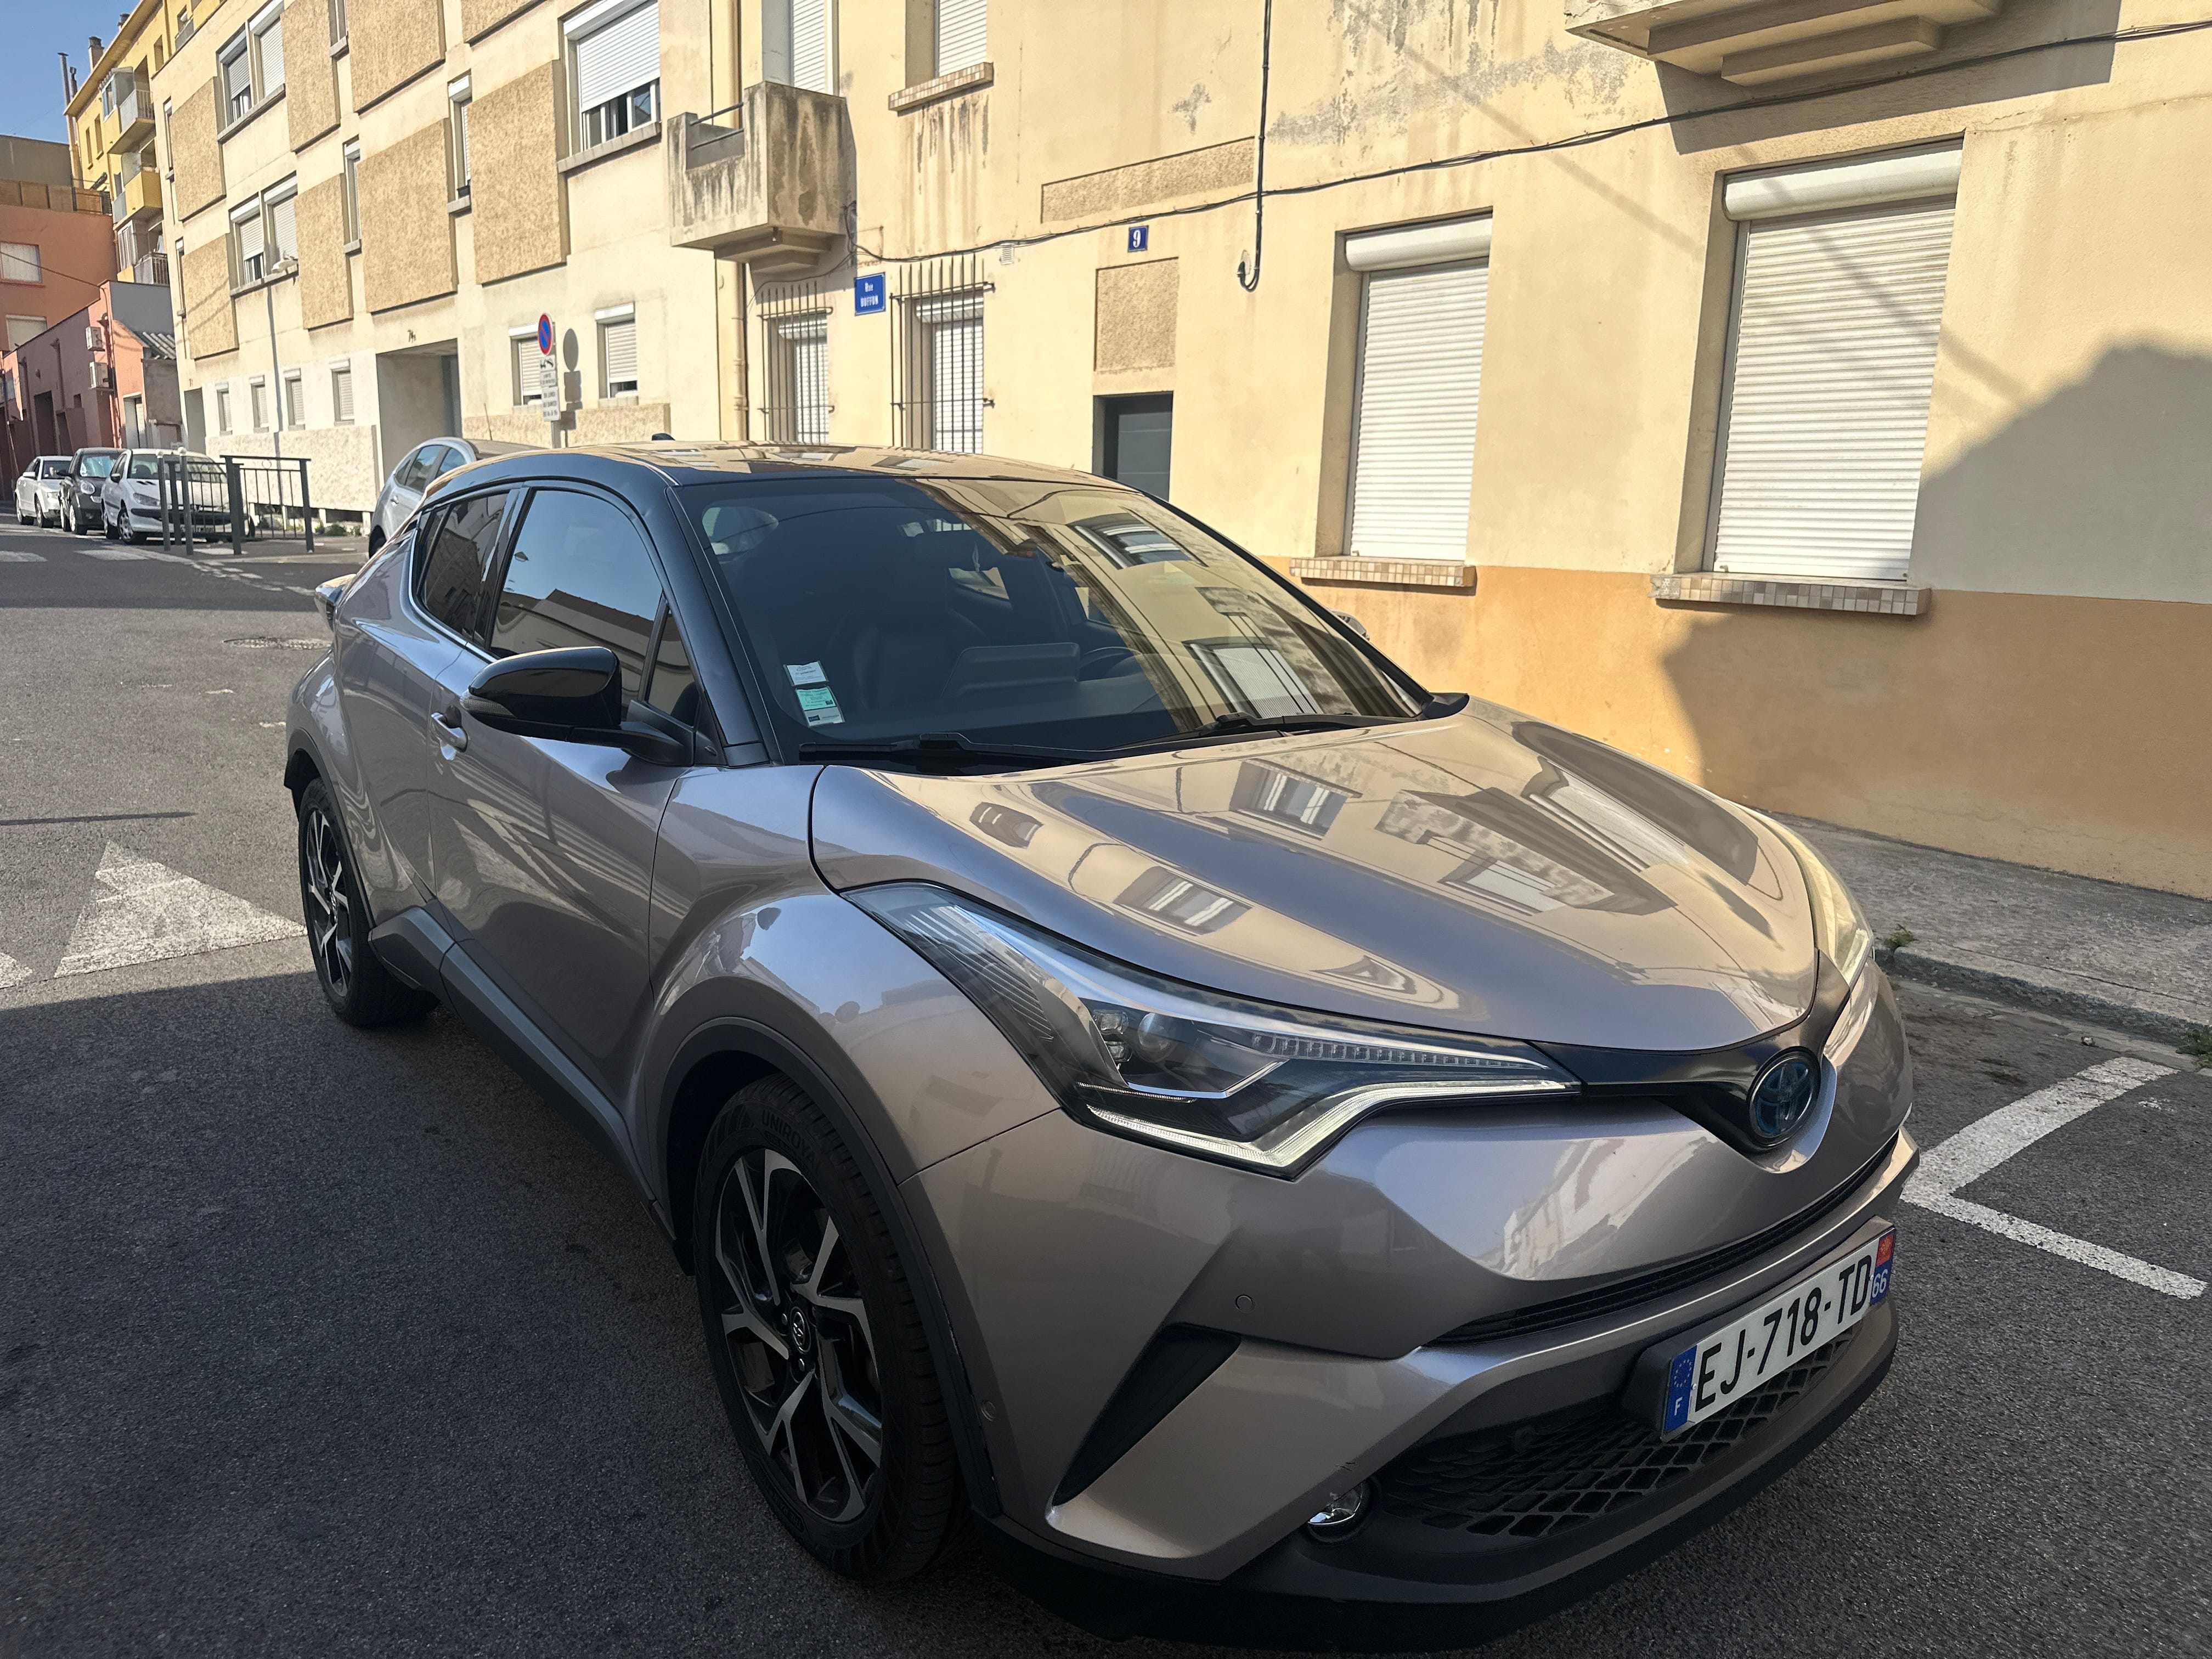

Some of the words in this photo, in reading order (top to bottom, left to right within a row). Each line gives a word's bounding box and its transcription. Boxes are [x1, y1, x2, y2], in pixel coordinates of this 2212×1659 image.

[1133, 229, 1141, 248] 9
[864, 281, 874, 292] Rue
[761, 1109, 816, 1167] UNIROYA
[1673, 1396, 1683, 1416] F
[1695, 1254, 1872, 1412] EJ-718-TD
[1871, 1268, 1889, 1299] 66
